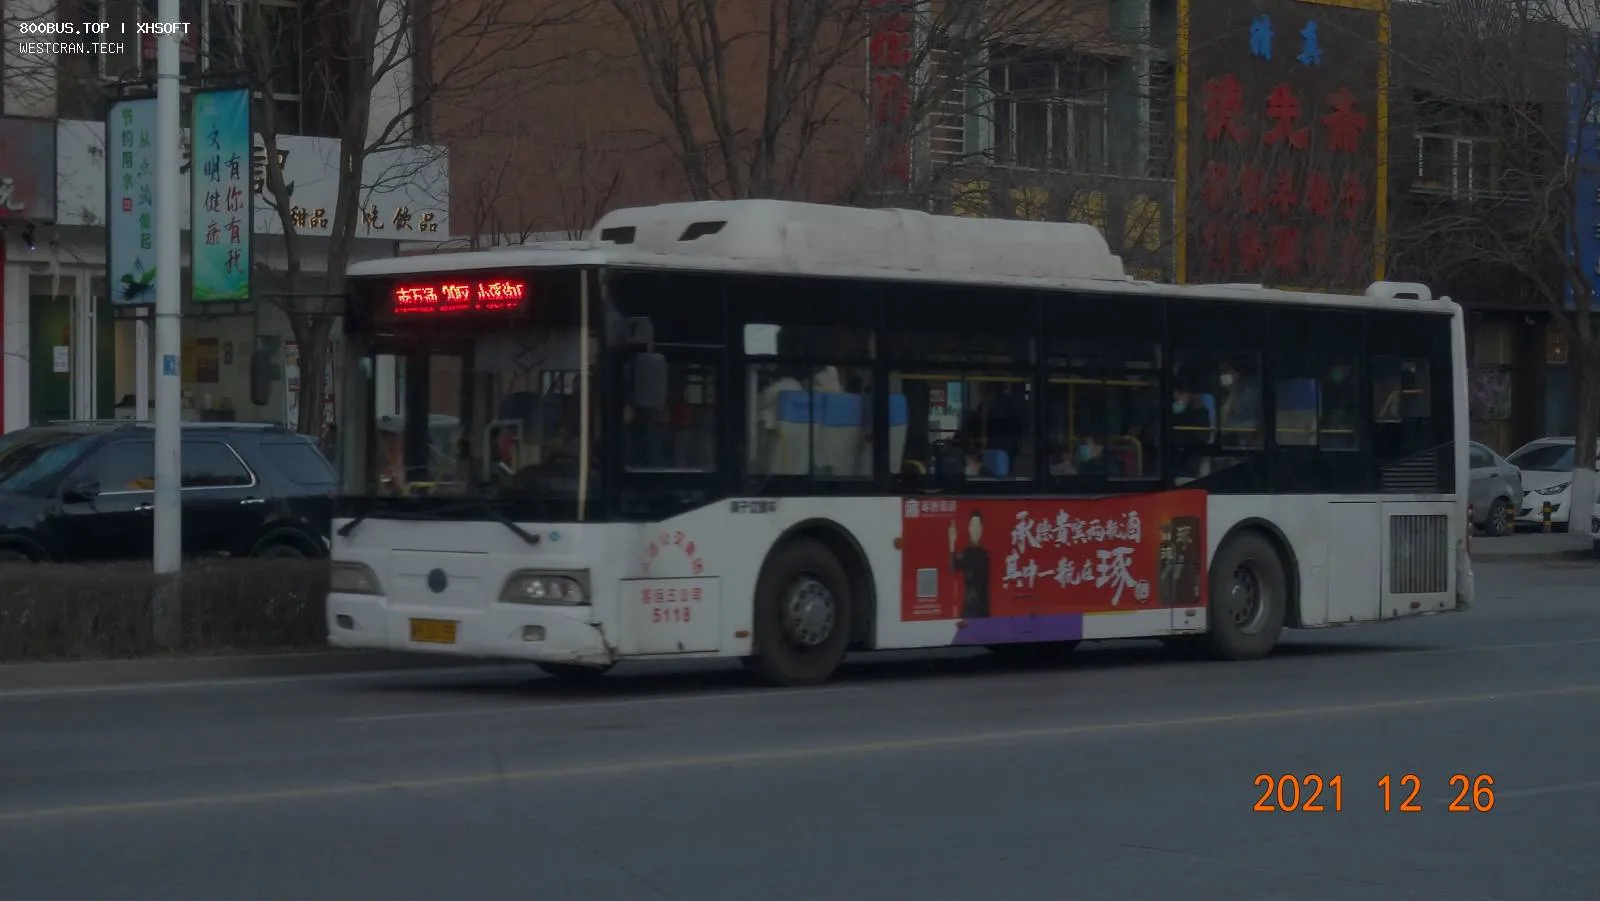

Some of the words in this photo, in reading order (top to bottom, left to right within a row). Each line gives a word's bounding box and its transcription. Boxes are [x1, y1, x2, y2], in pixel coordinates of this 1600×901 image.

[121, 108, 134, 191] 节约用水
[205, 123, 221, 246] 文明健康
[224, 152, 244, 275] 有你有我
